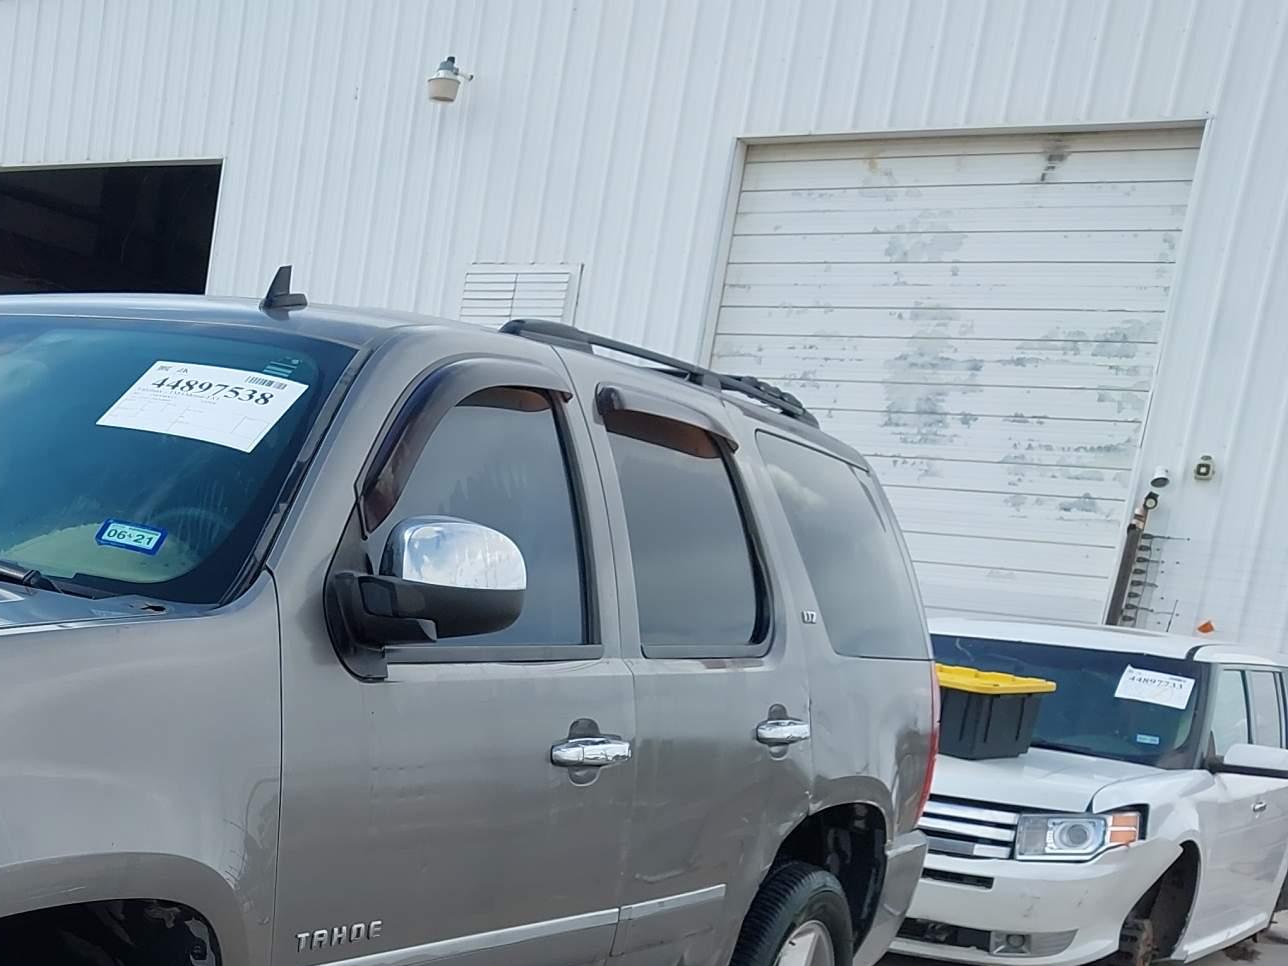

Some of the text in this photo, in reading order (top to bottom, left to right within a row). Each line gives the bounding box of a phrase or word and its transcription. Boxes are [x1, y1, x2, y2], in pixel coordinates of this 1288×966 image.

[152, 377, 274, 406] 44897538
[107, 528, 154, 546] 06 21
[296, 920, 382, 952] TAHOE
